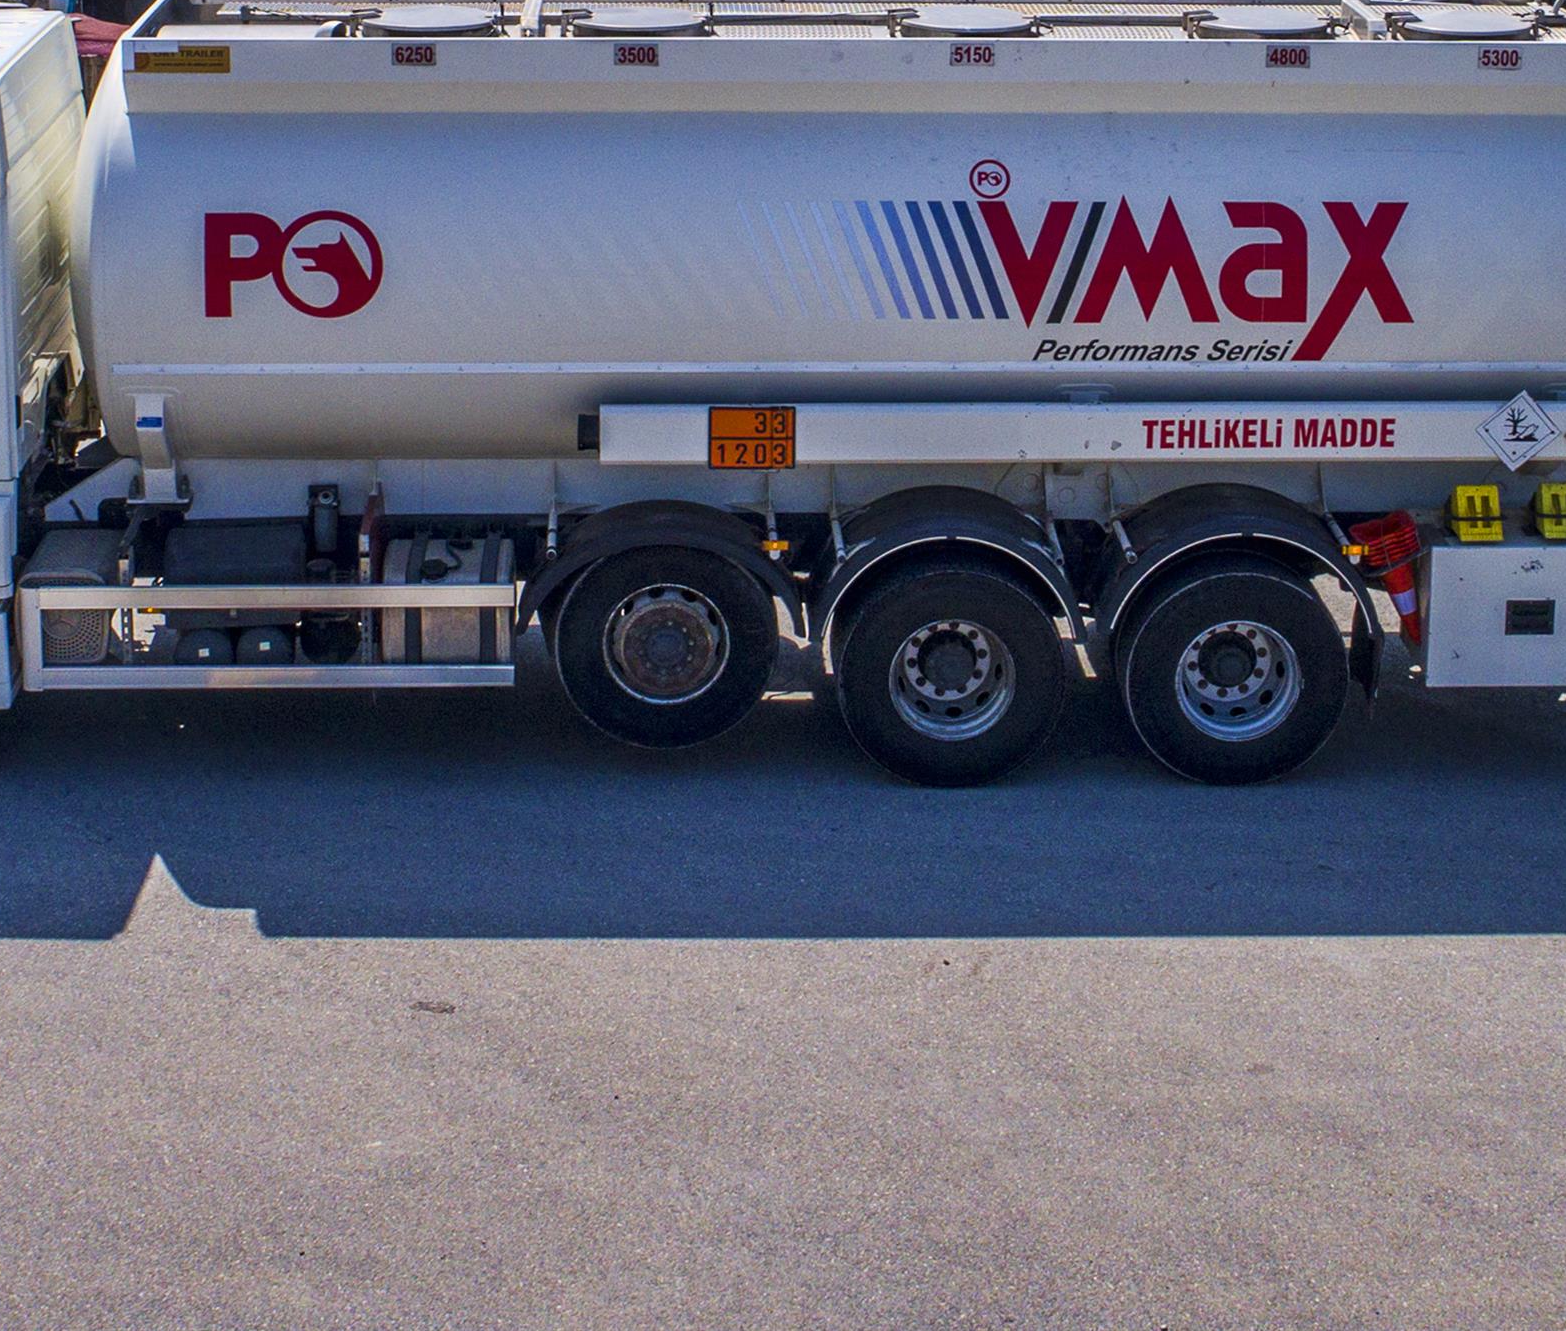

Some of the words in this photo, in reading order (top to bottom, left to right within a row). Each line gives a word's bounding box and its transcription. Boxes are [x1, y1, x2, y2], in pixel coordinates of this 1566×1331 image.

[394, 46, 434, 64] 6250
[616, 46, 656, 64] 3500
[953, 46, 993, 64] 5150
[1268, 48, 1308, 66] 4800
[1480, 49, 1520, 67] 5300
[1032, 338, 1200, 363] Performans
[1206, 339, 1293, 362] Serisi
[754, 411, 786, 435] 33
[1293, 417, 1397, 449] MADDE
[716, 442, 786, 466] 1203
